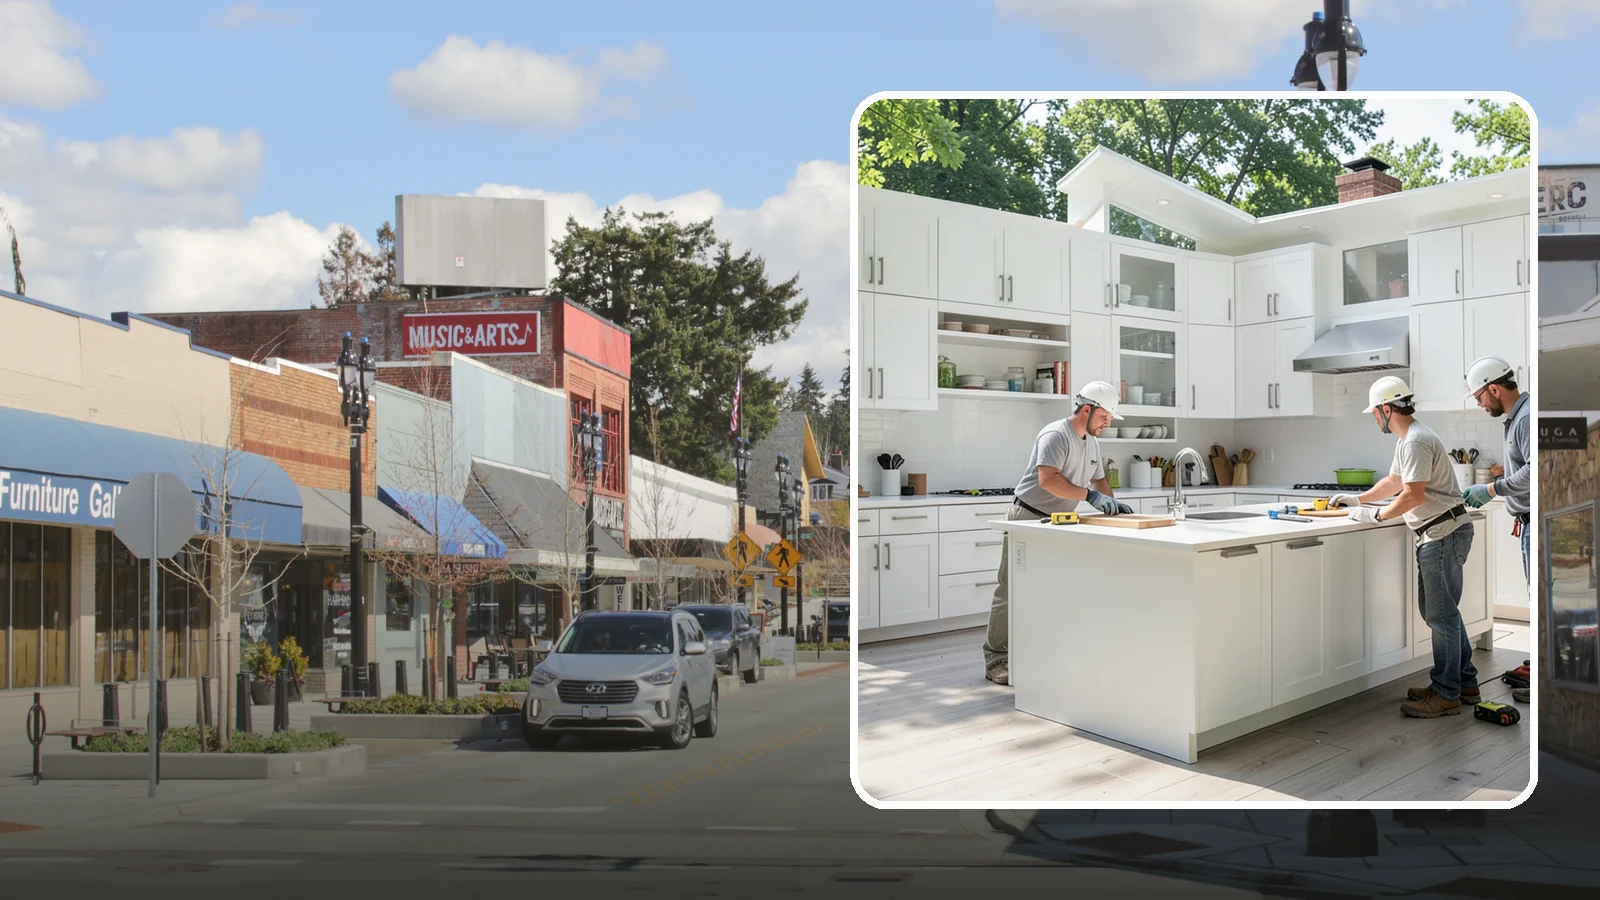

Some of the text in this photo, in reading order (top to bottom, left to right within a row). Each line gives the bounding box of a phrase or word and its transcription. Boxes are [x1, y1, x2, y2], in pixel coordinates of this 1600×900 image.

[409, 323, 520, 348] MUSIC&ARTS
[0, 471, 122, 520] Furniture Gal
[453, 563, 479, 574] SUSHI
